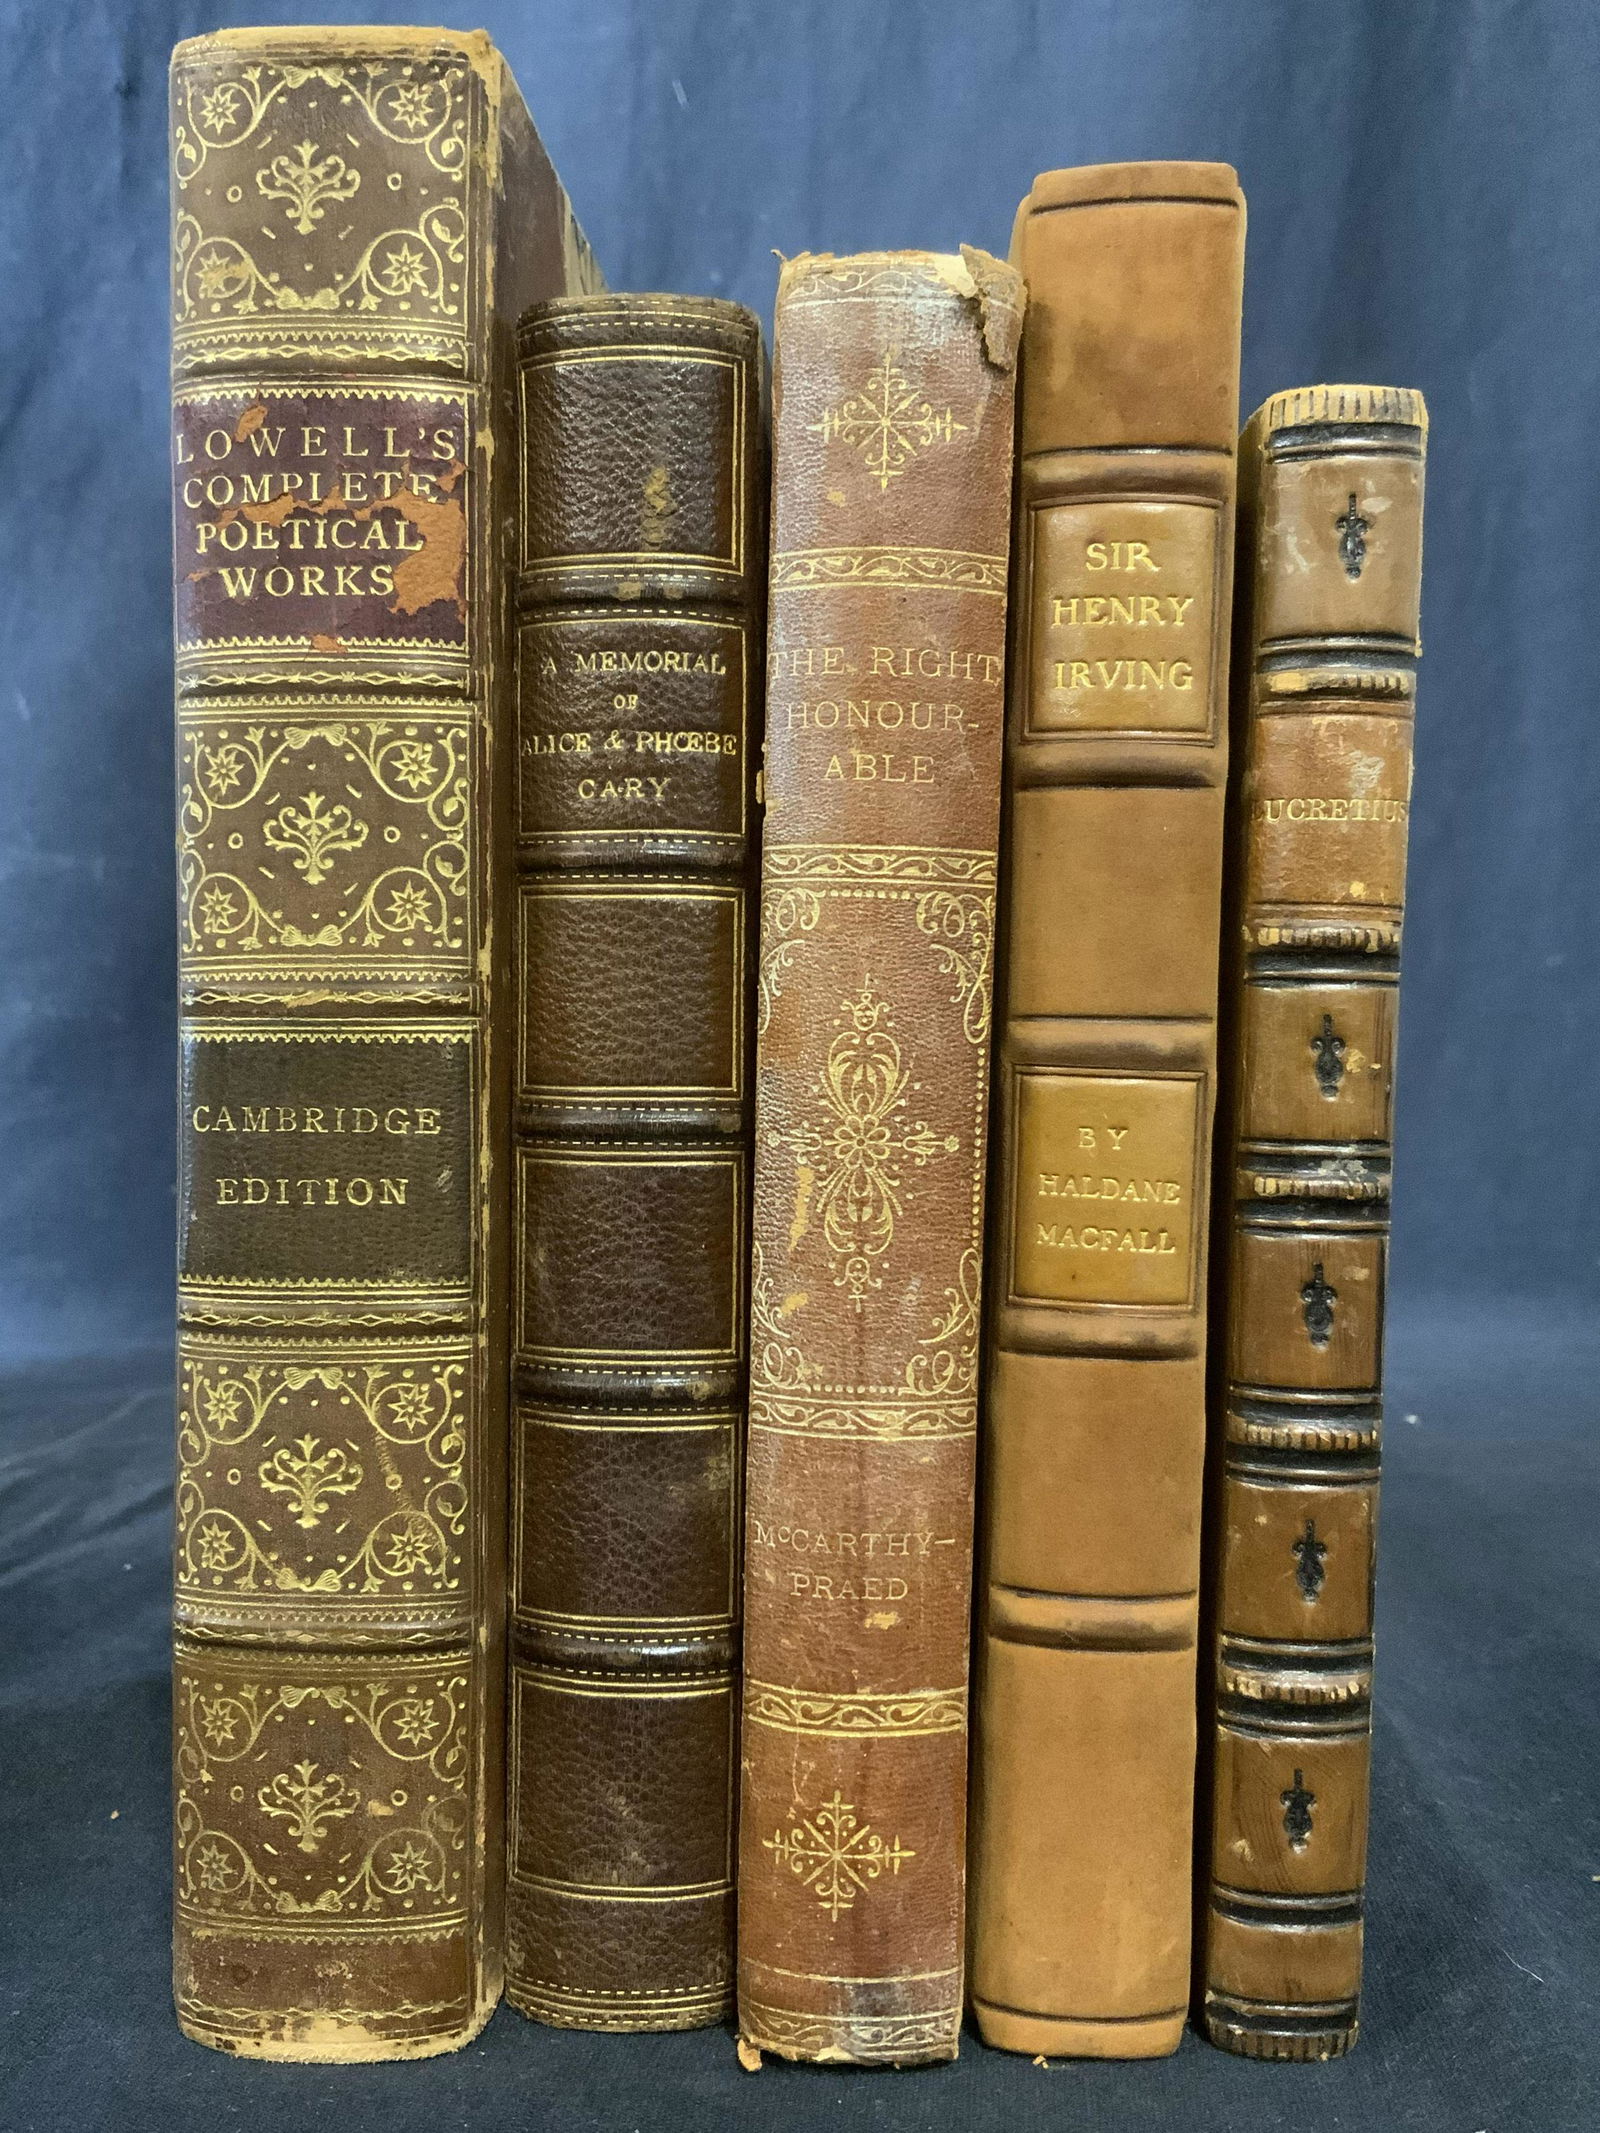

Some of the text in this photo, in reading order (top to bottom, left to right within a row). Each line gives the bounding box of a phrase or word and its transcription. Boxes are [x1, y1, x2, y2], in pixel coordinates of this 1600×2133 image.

[176, 427, 456, 464] LOWELL'S
[195, 519, 424, 554] POETICAL
[1085, 541, 1161, 572] SIR
[218, 564, 395, 599] WORKS
[1051, 595, 1194, 629] HENRY
[542, 650, 727, 676] A MEMORIAL
[768, 646, 1001, 683] THE RIGHT
[1053, 660, 1194, 690] IRVING
[613, 694, 639, 710] OF
[786, 700, 979, 734] HONOUR-
[521, 732, 592, 756] ALICE
[604, 729, 624, 750] &
[824, 754, 936, 784] ABLE
[578, 776, 672, 800] CARY
[192, 1105, 442, 1135] CAMBRIDGE
[1078, 1126, 1129, 1150] BY
[215, 1178, 409, 1206] EDITION
[1038, 1172, 1181, 1206] HALDANE
[1036, 1222, 1176, 1254] MACFALL
[787, 1570, 909, 1601] PRAED
